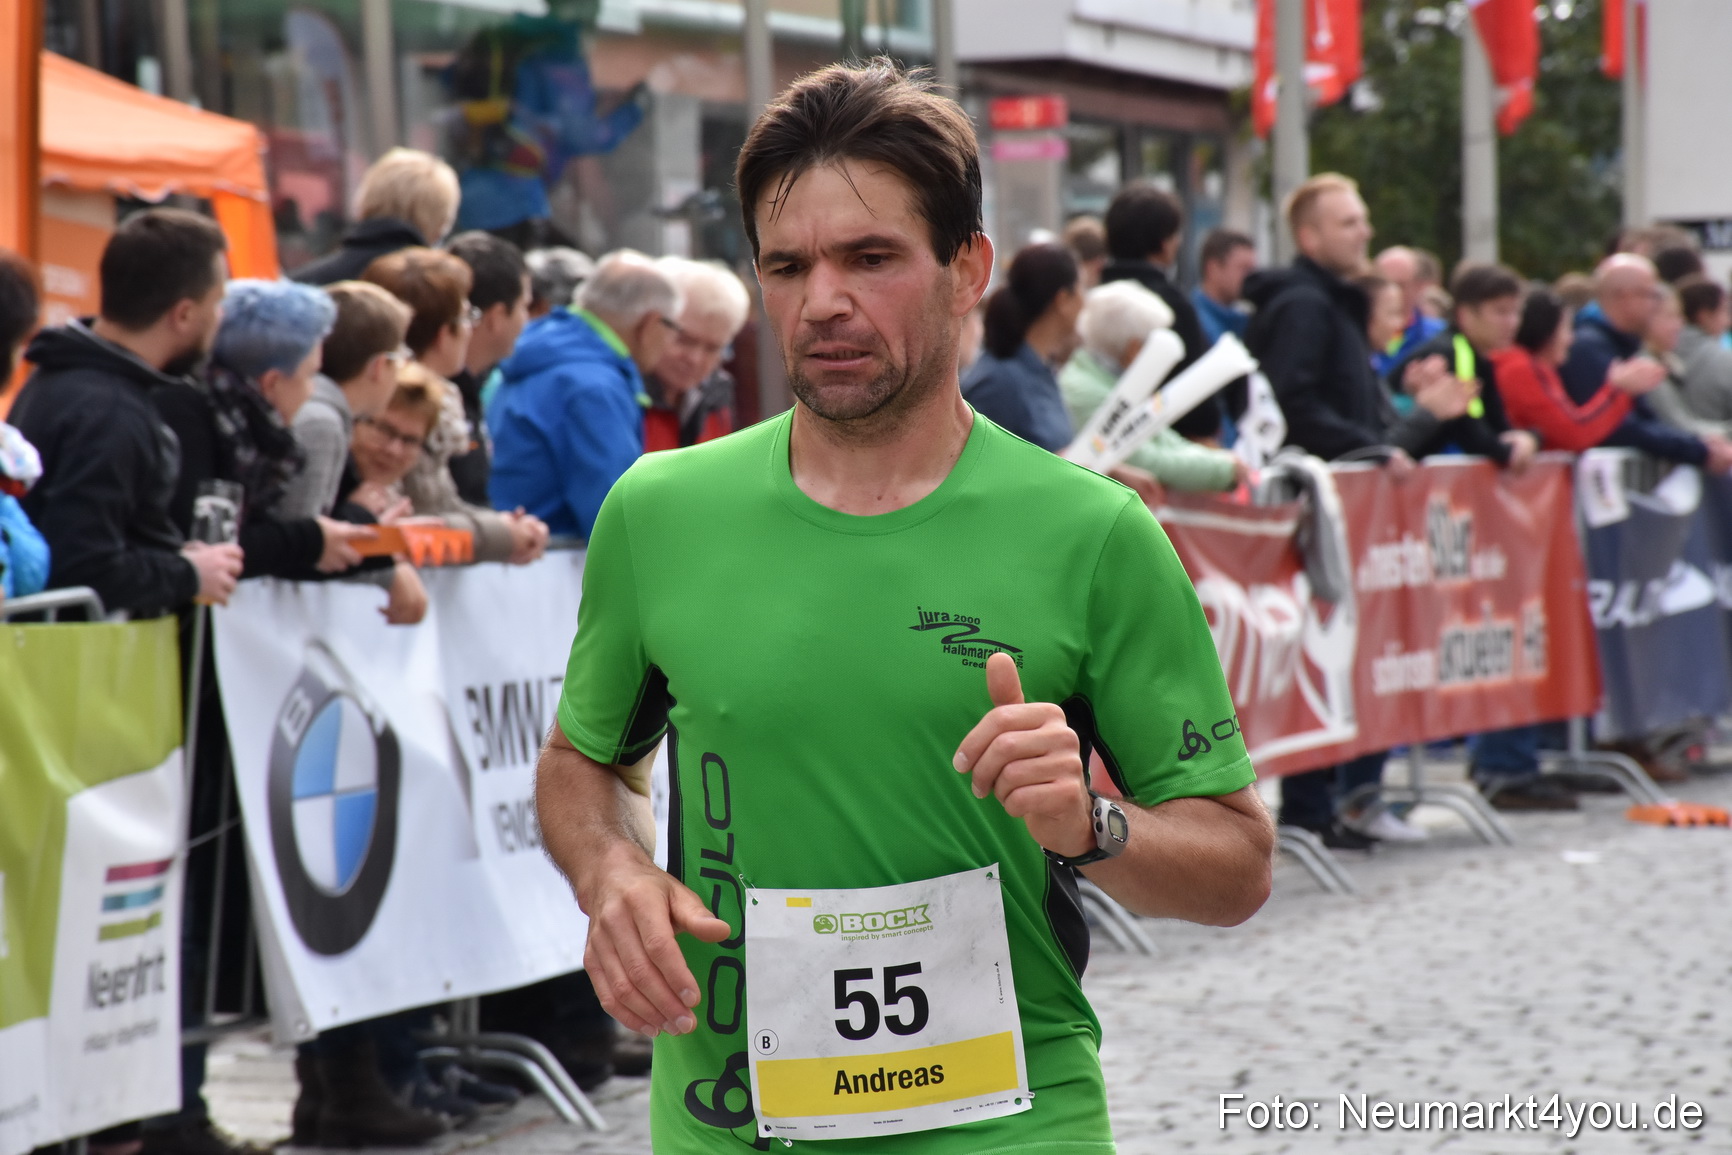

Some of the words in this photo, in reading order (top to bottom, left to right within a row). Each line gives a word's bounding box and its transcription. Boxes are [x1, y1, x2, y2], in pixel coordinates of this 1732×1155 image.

[917, 606, 950, 631] jura
[953, 614, 981, 625] 2000
[840, 904, 932, 934] BOCK
[841, 933, 869, 942] inspired
[871, 932, 880, 940] by
[881, 930, 902, 938] smart
[903, 925, 934, 936] concepts
[833, 961, 930, 1041] 55
[762, 1036, 771, 1049] B
[834, 1064, 945, 1096] Andreas
